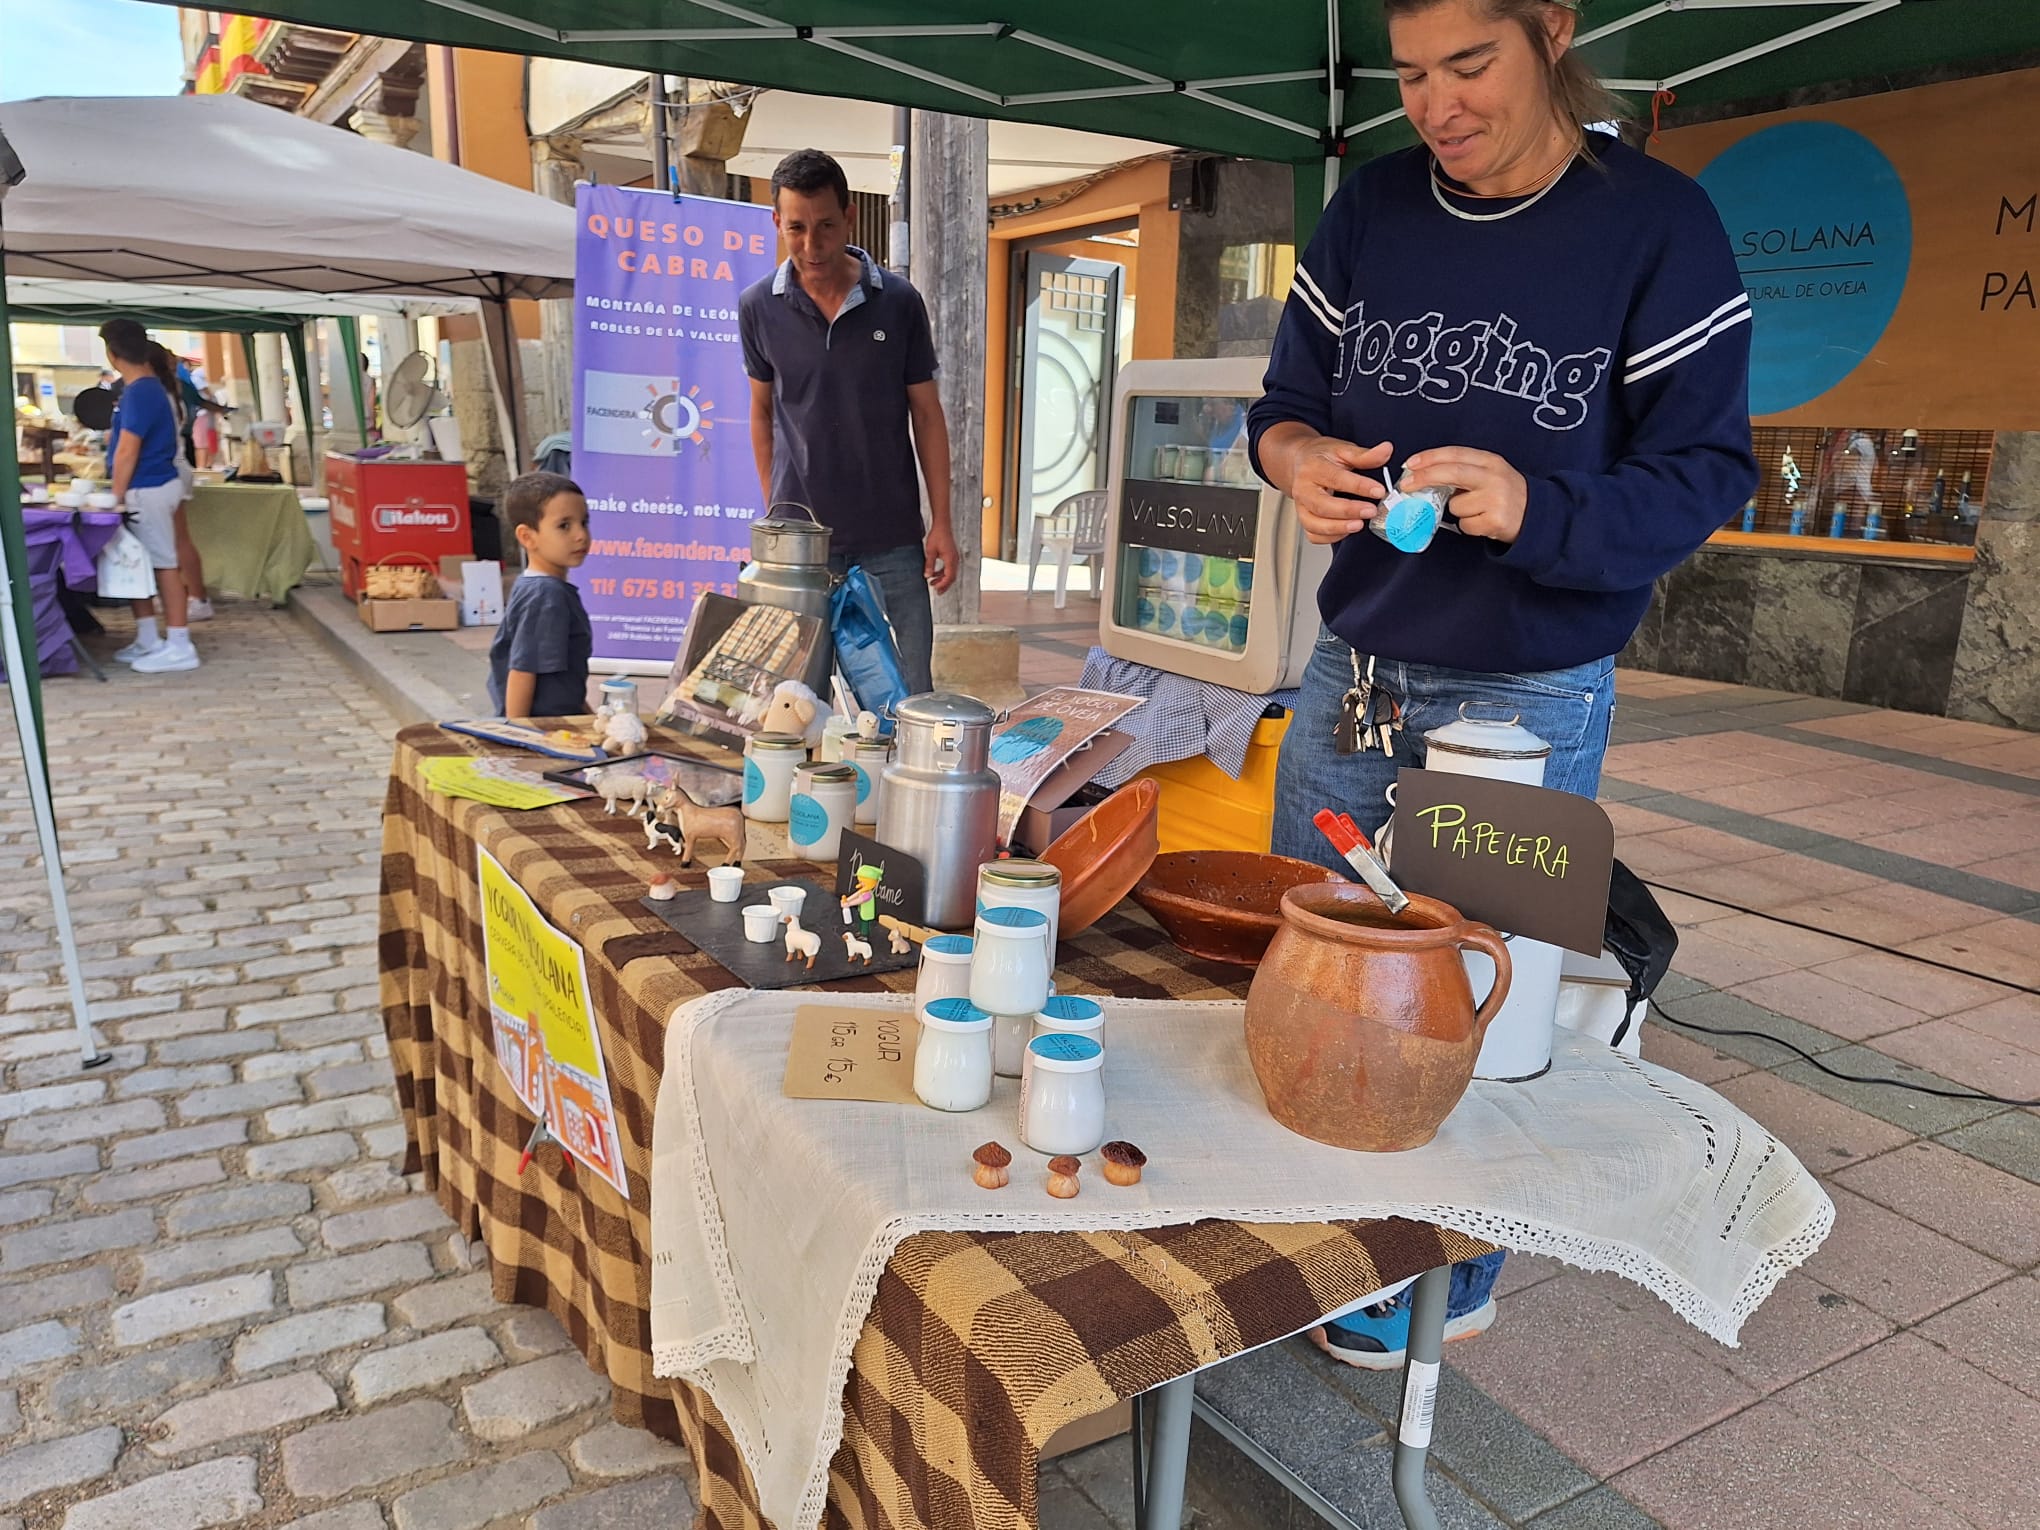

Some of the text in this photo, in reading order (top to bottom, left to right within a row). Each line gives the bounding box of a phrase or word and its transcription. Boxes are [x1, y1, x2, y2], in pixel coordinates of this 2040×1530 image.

[587, 214, 766, 255] QUESO DE
[1734, 222, 1875, 258] SOLANA
[617, 250, 734, 282] CABRA
[1795, 283, 1814, 298] DE
[1819, 280, 1867, 297] OVEJA
[586, 296, 739, 321] MONTAÑA DE LEÓN
[590, 321, 641, 335] ROBLES
[646, 326, 663, 337] DE
[668, 328, 684, 338] LA
[1331, 300, 1612, 431] jogging
[586, 407, 637, 419] FACENDERA
[586, 496, 755, 519] make cheese, not war
[1129, 497, 1247, 538] VALSOLANA
[590, 578, 616, 595] Tlf
[622, 578, 658, 599] 675
[662, 579, 685, 600] 81
[1056, 705, 1101, 722] OVEJA
[1416, 804, 1570, 879] PAPELERA
[877, 1019, 901, 1062] YOGUR
